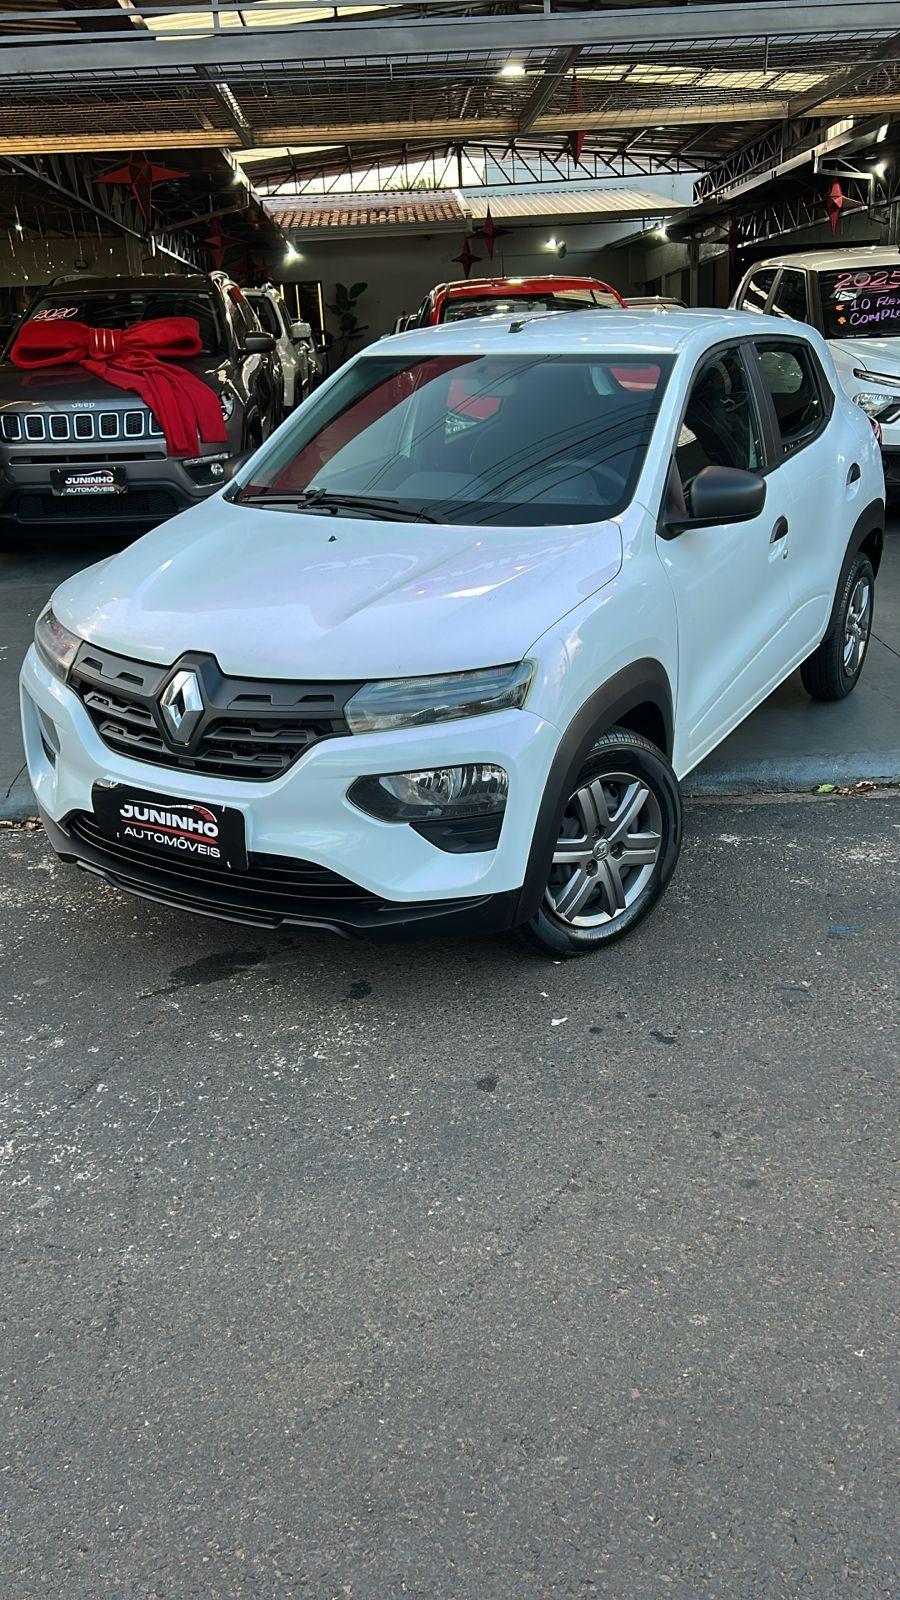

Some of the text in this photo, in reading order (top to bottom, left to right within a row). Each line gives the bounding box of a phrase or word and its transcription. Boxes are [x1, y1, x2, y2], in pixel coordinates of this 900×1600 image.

[32, 307, 79, 319] 2020
[65, 476, 114, 484] JUNINHO
[119, 804, 219, 837] JUNINHO
[124, 827, 221, 858] AUTOMÓVEIS
